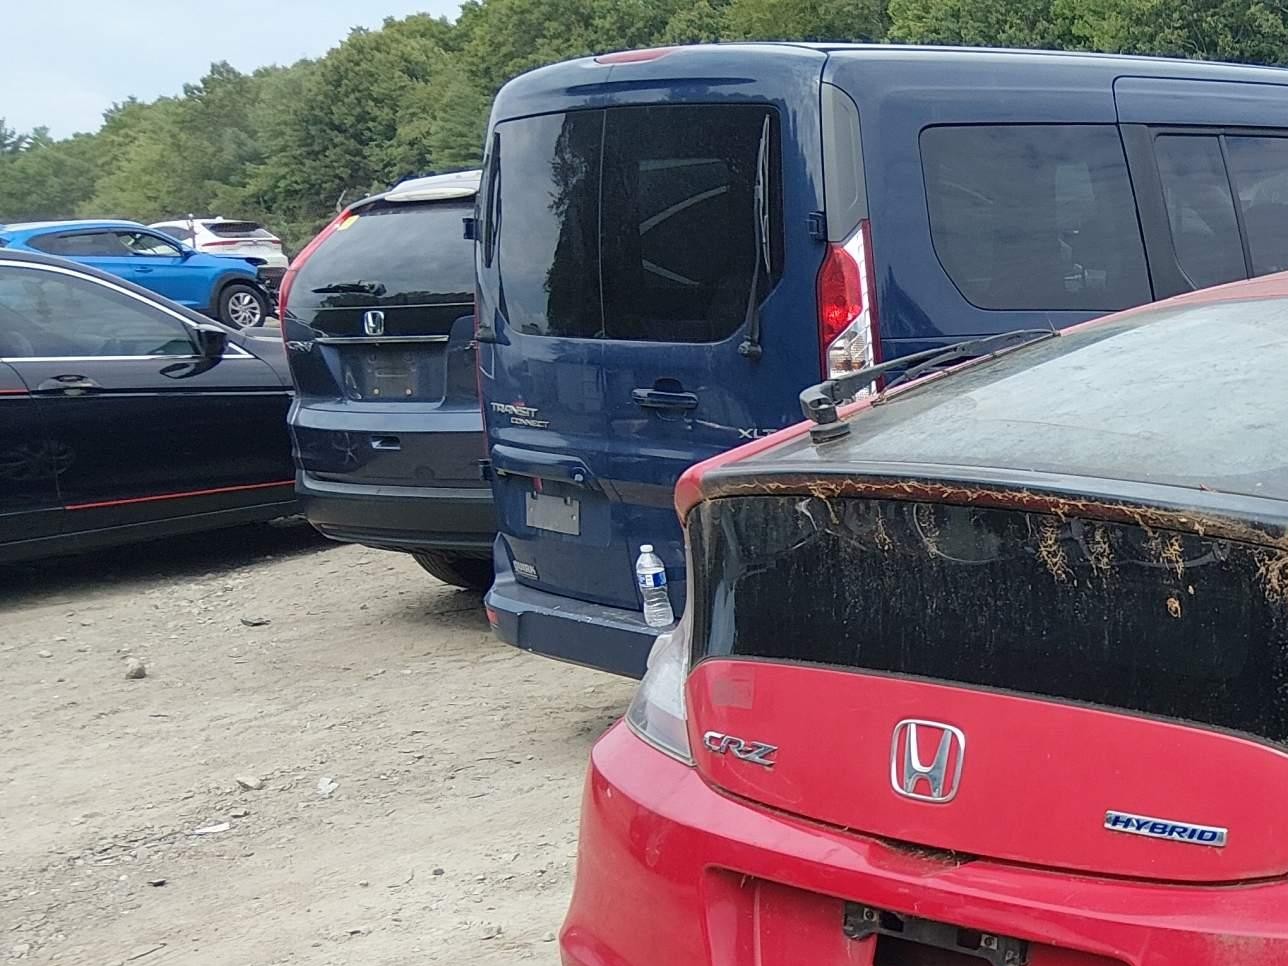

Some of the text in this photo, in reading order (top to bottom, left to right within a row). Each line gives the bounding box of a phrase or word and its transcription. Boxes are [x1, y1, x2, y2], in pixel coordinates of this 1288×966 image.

[490, 401, 539, 417] TRANSIT
[510, 416, 551, 429] CONNECT
[703, 730, 779, 767] CR-Z
[1110, 814, 1219, 842] HYBRID
